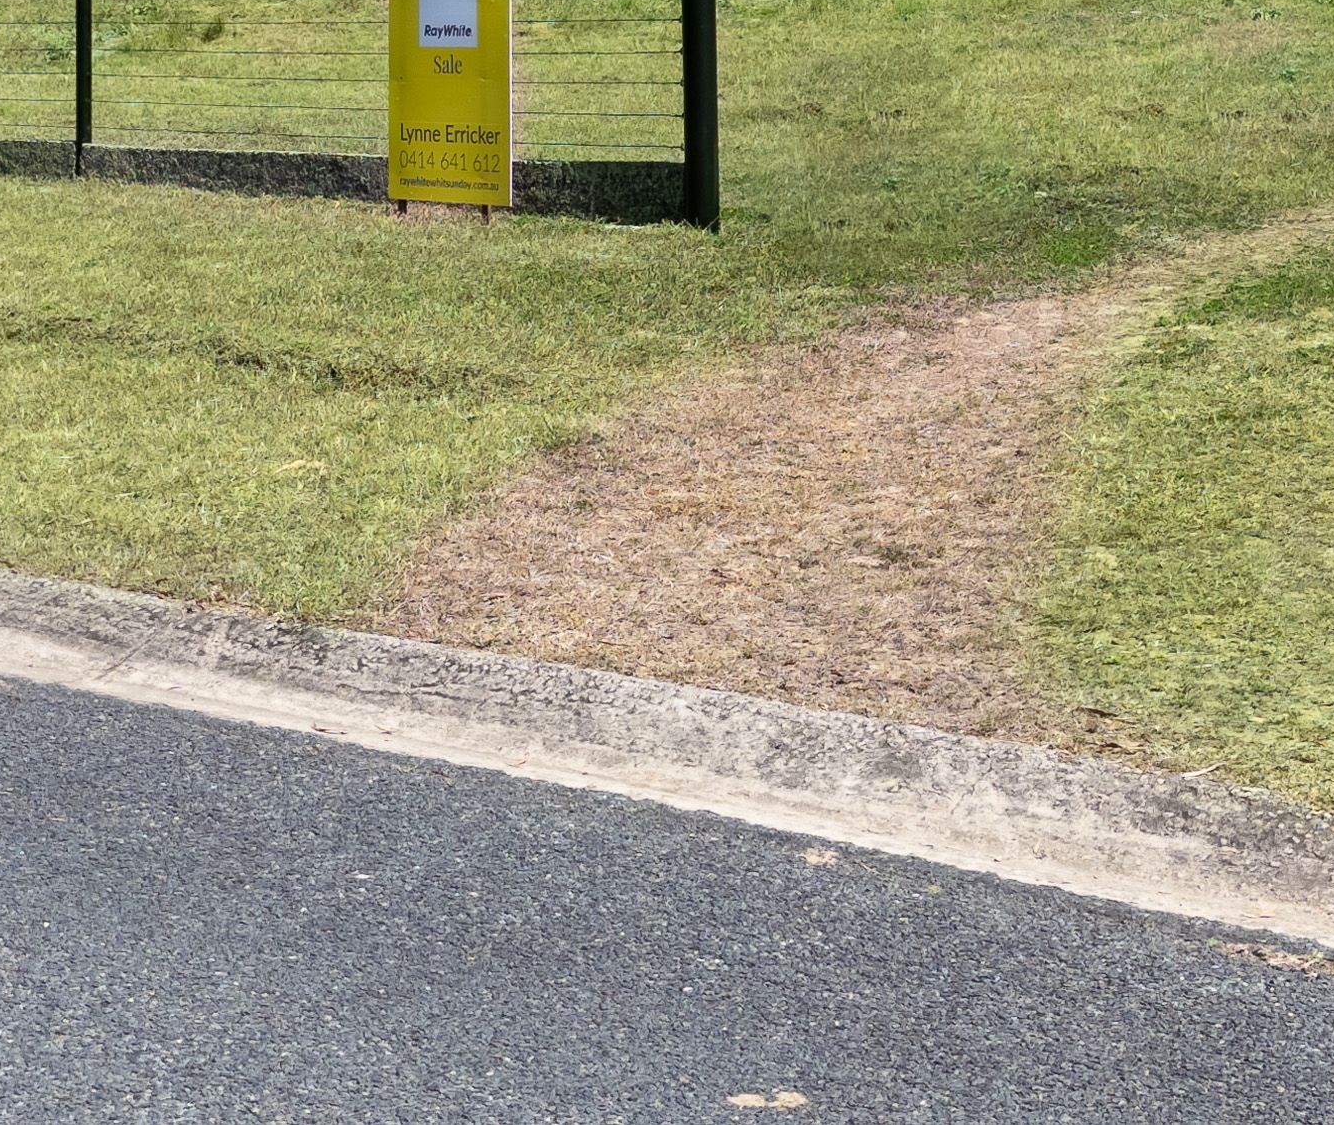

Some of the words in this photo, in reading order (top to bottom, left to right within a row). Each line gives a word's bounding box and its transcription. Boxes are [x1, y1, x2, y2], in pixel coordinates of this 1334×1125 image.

[433, 54, 463, 74] Sale
[400, 122, 441, 145] Lynne
[445, 124, 501, 145] Erricker
[399, 149, 435, 169] 0414
[440, 152, 468, 172] 641
[472, 154, 501, 173] 612
